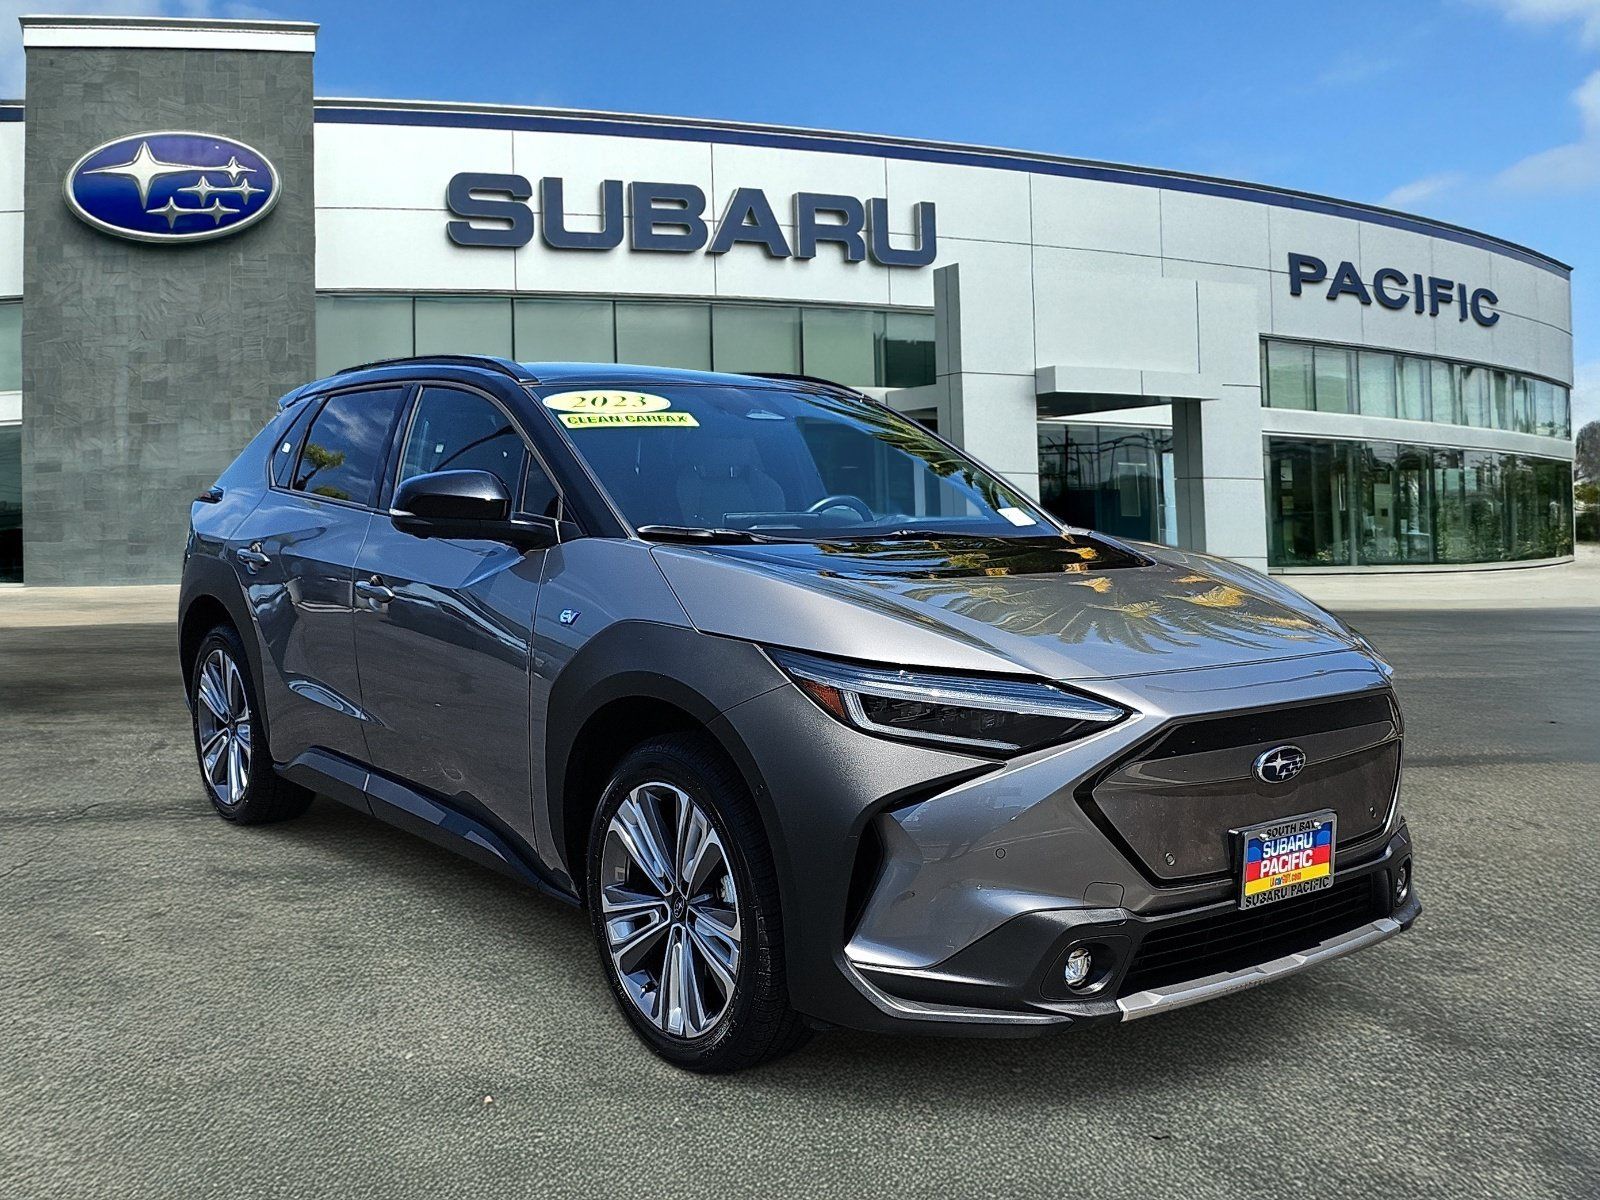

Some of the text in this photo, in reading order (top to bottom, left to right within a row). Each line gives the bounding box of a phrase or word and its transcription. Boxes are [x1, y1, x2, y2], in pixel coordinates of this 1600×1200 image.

[447, 171, 937, 267] SUBARU
[1288, 252, 1500, 326] PACIFIC
[572, 396, 647, 408] 2023
[567, 415, 687, 425] CLEAN CARFAX
[1266, 819, 1319, 839] SOUTH BAY
[1263, 832, 1313, 858] SUBARU
[1260, 850, 1313, 877] PACIFIC
[1245, 876, 1330, 907] SUBARU PACIFIC
